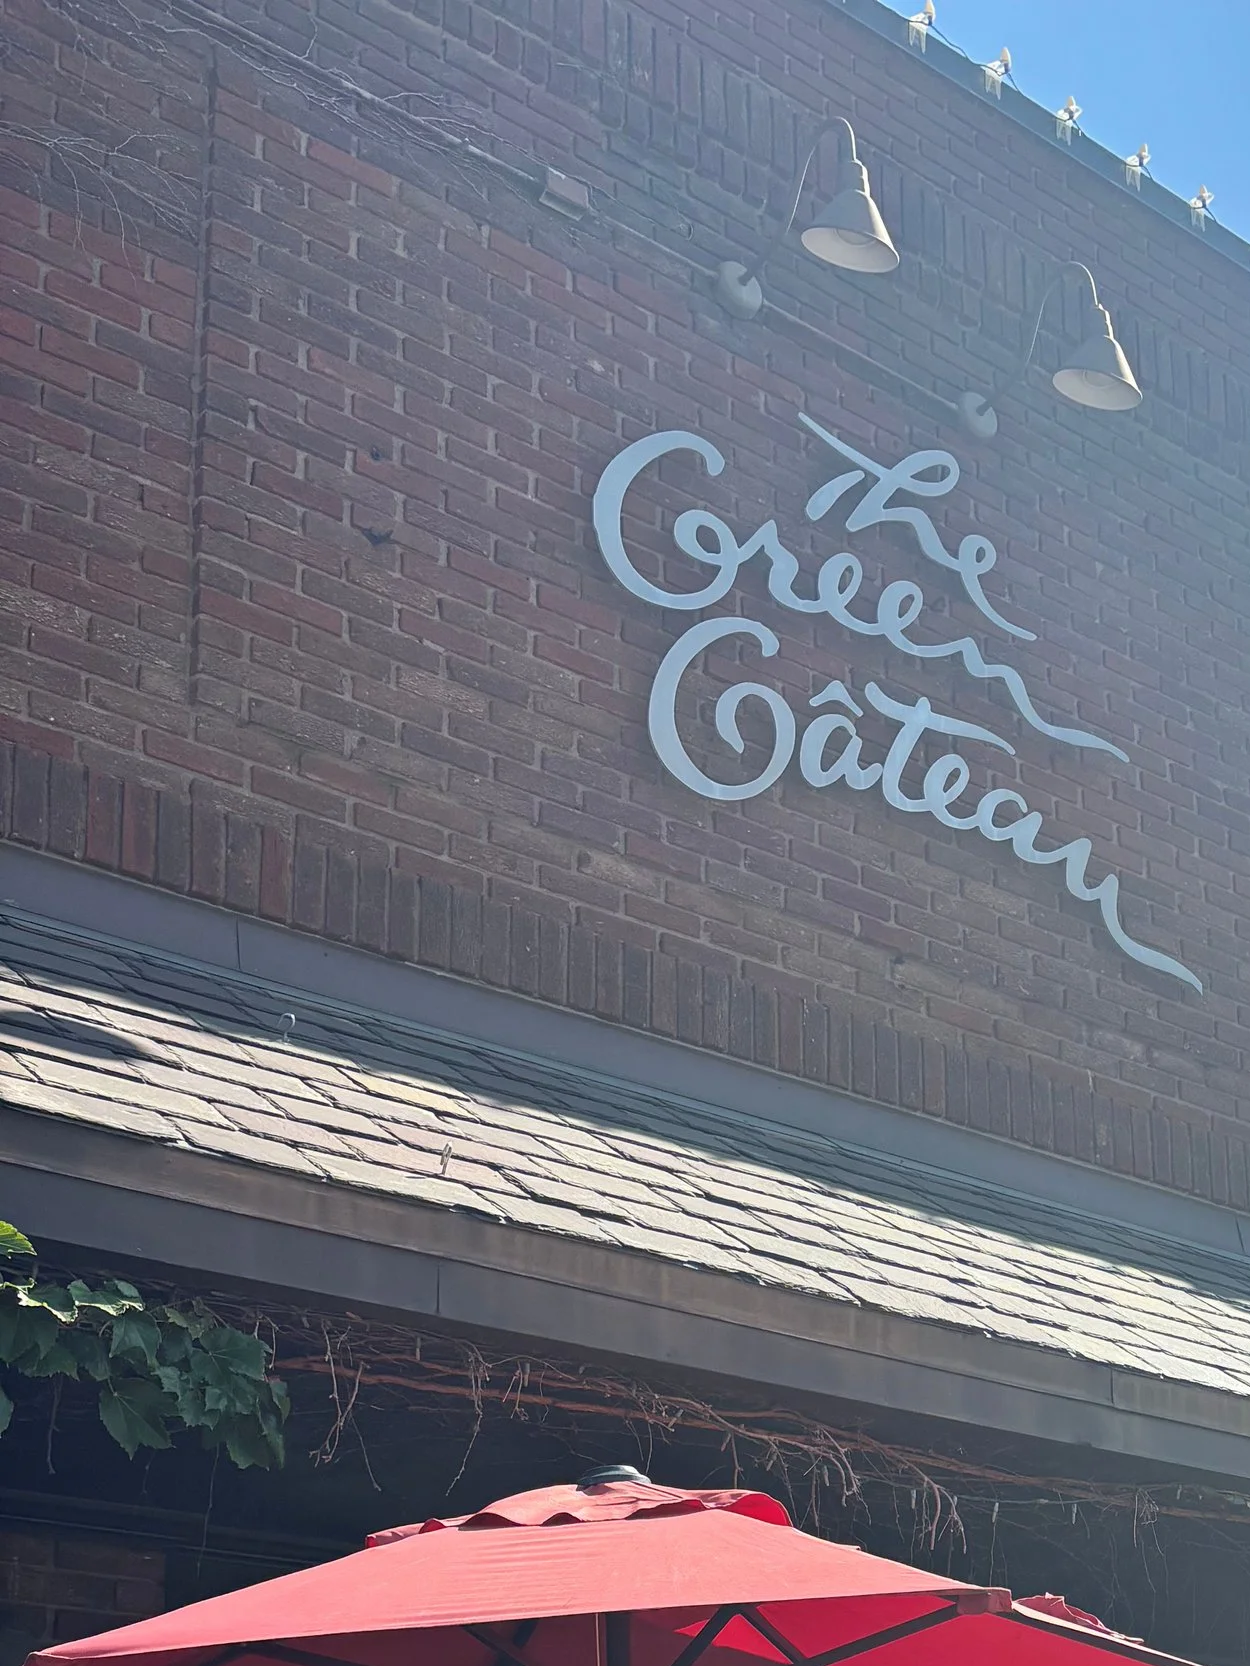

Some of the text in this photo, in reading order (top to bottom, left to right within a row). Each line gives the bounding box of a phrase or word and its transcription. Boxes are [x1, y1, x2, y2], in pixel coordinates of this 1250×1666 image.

[593, 430, 1131, 763] Green
[799, 411, 1039, 641] The
[648, 616, 1204, 996] Gâteau
